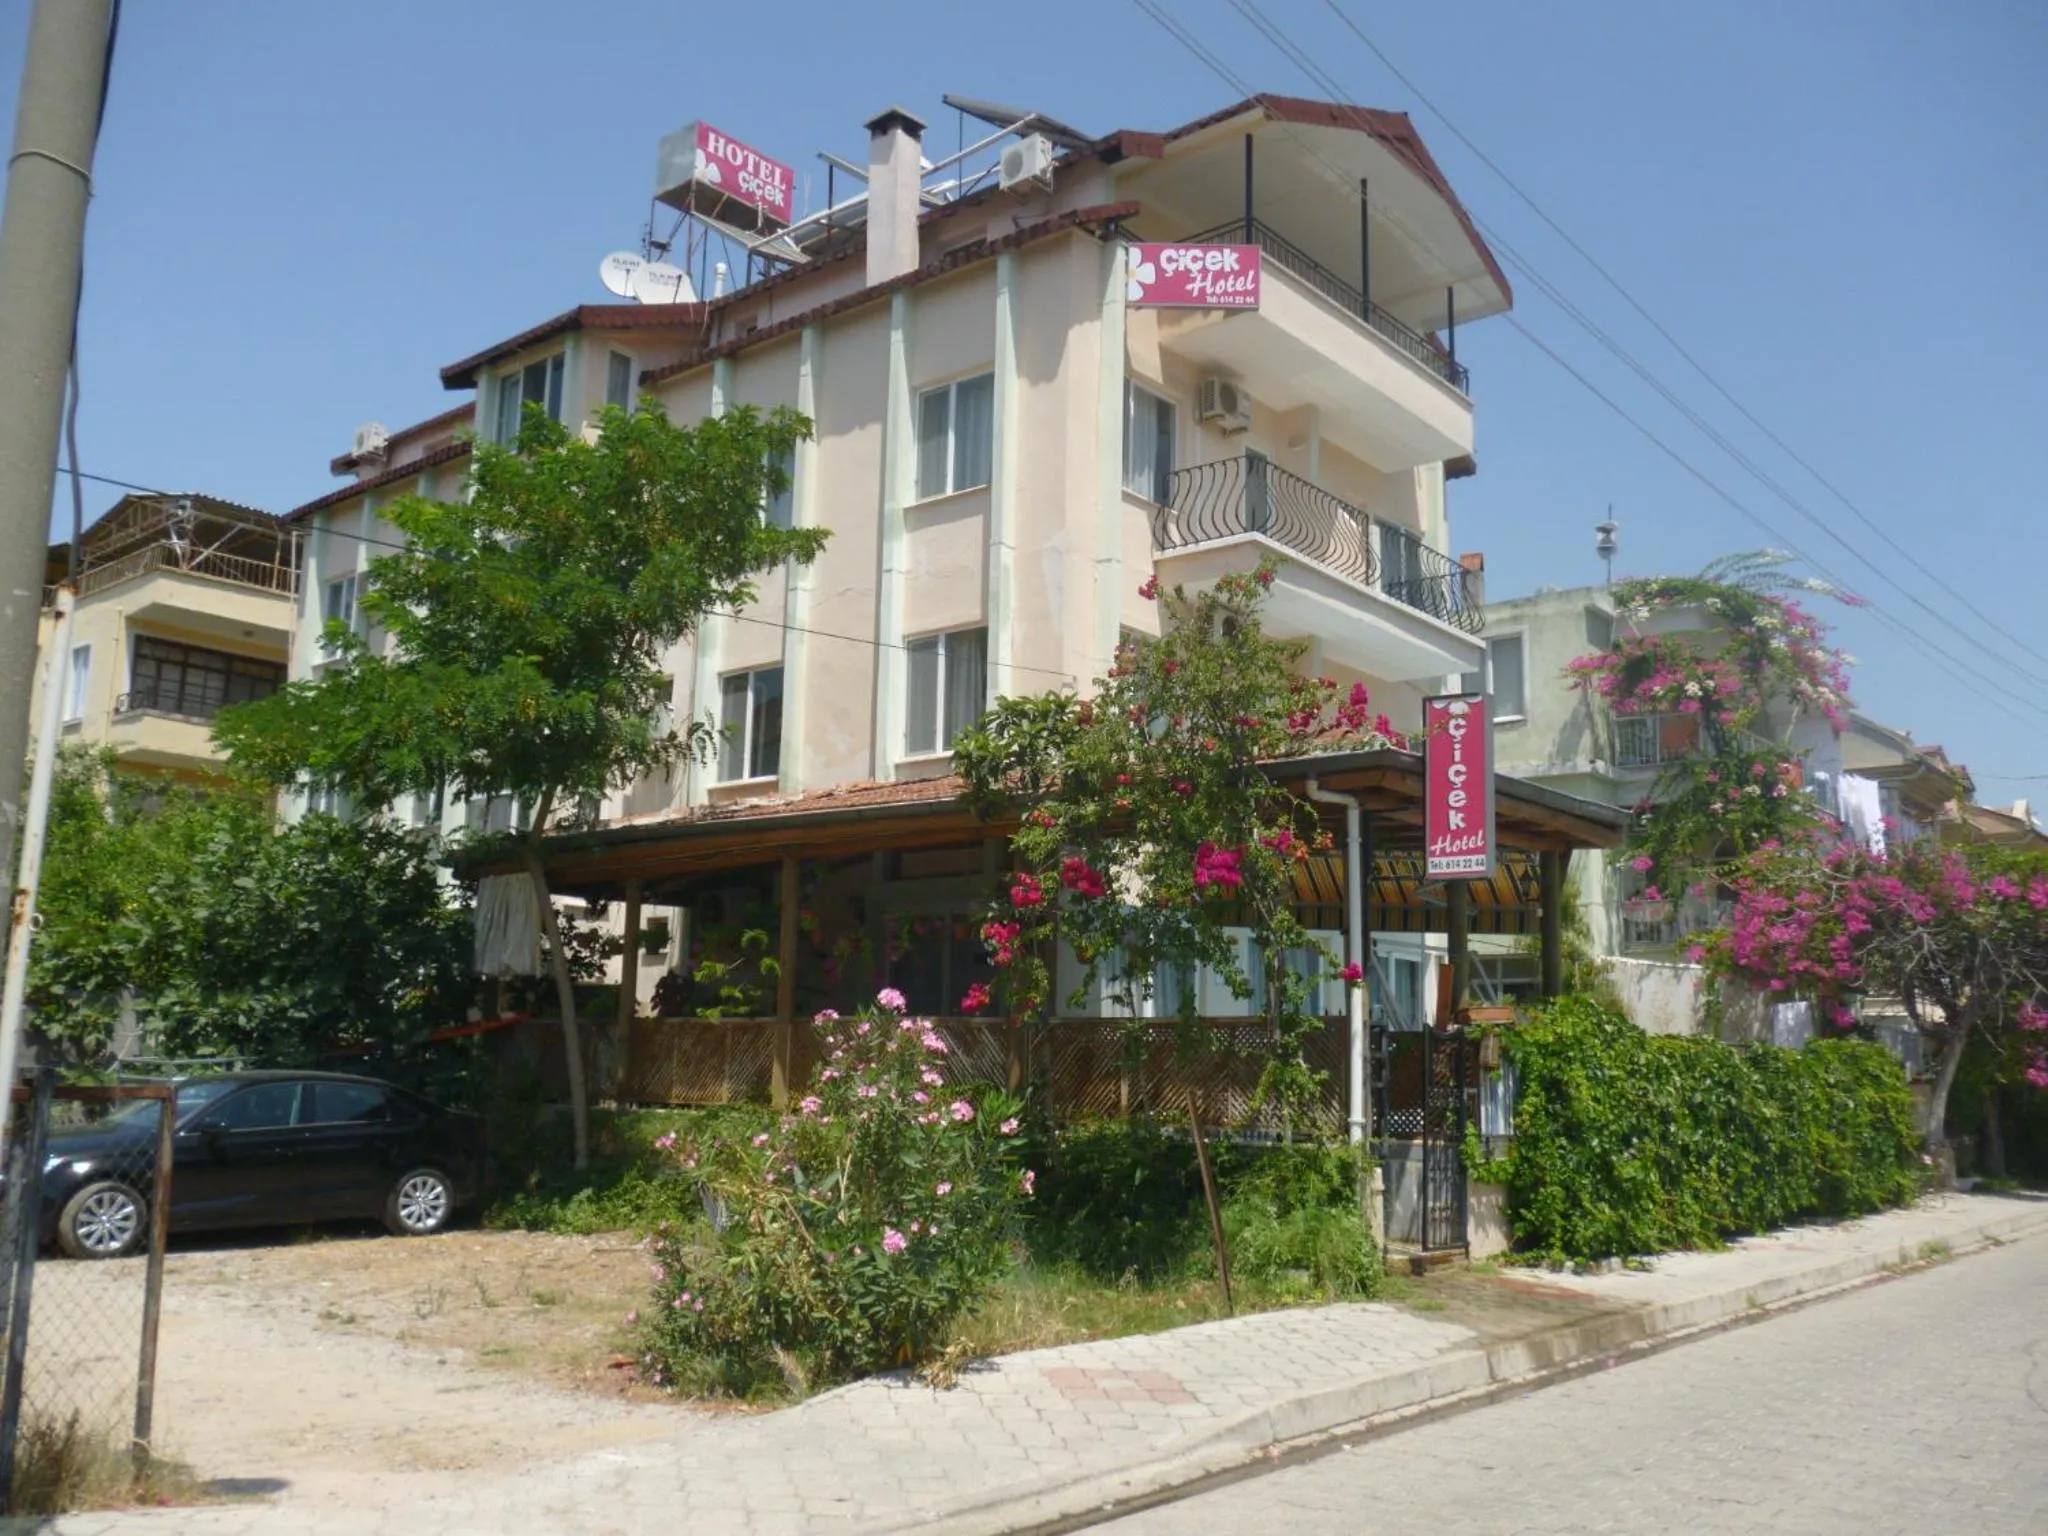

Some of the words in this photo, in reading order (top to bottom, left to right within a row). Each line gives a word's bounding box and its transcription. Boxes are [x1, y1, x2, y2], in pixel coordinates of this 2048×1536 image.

[707, 131, 786, 190] HOTEL
[1185, 271, 1255, 297] Hotel
[1430, 830, 1484, 855] Hotel
[1446, 859, 1461, 870] 614
[1463, 858, 1473, 868] 22
[1474, 857, 1485, 868] 44
